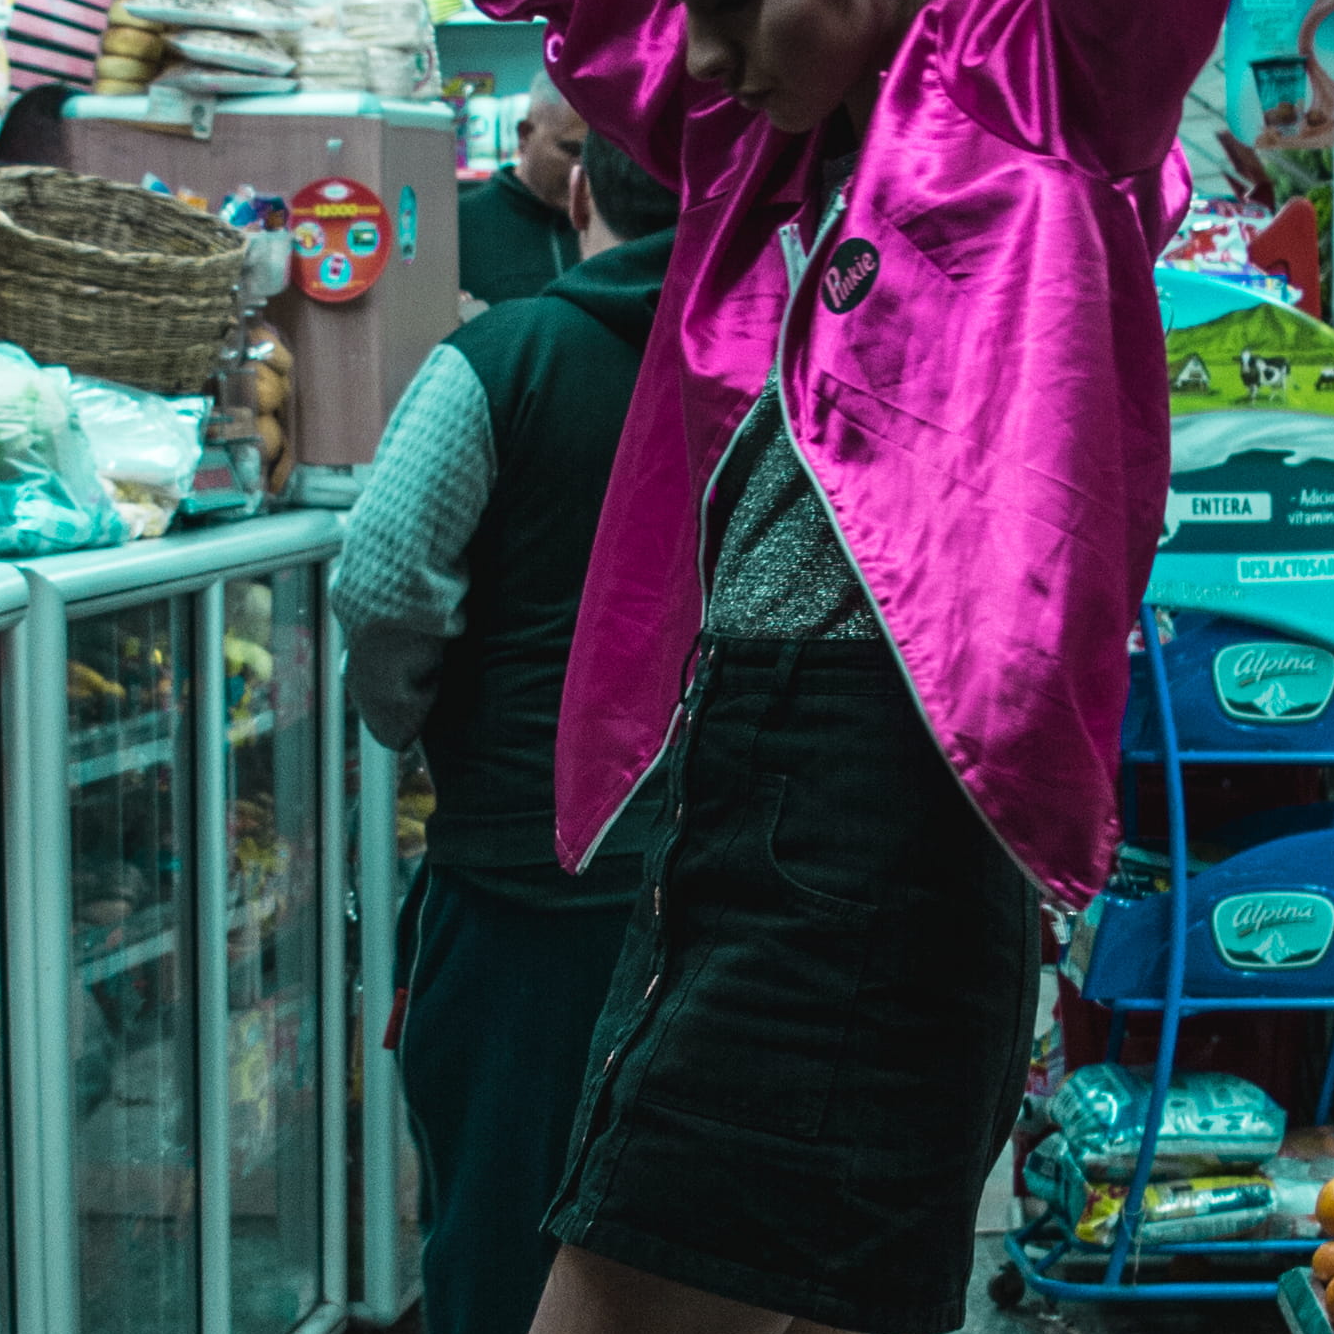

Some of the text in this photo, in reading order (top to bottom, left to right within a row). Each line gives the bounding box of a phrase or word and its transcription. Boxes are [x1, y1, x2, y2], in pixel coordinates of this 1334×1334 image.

[1191, 497, 1253, 516] ENTERA
[1234, 651, 1316, 681] Alpina
[1232, 904, 1315, 931] Alpina
